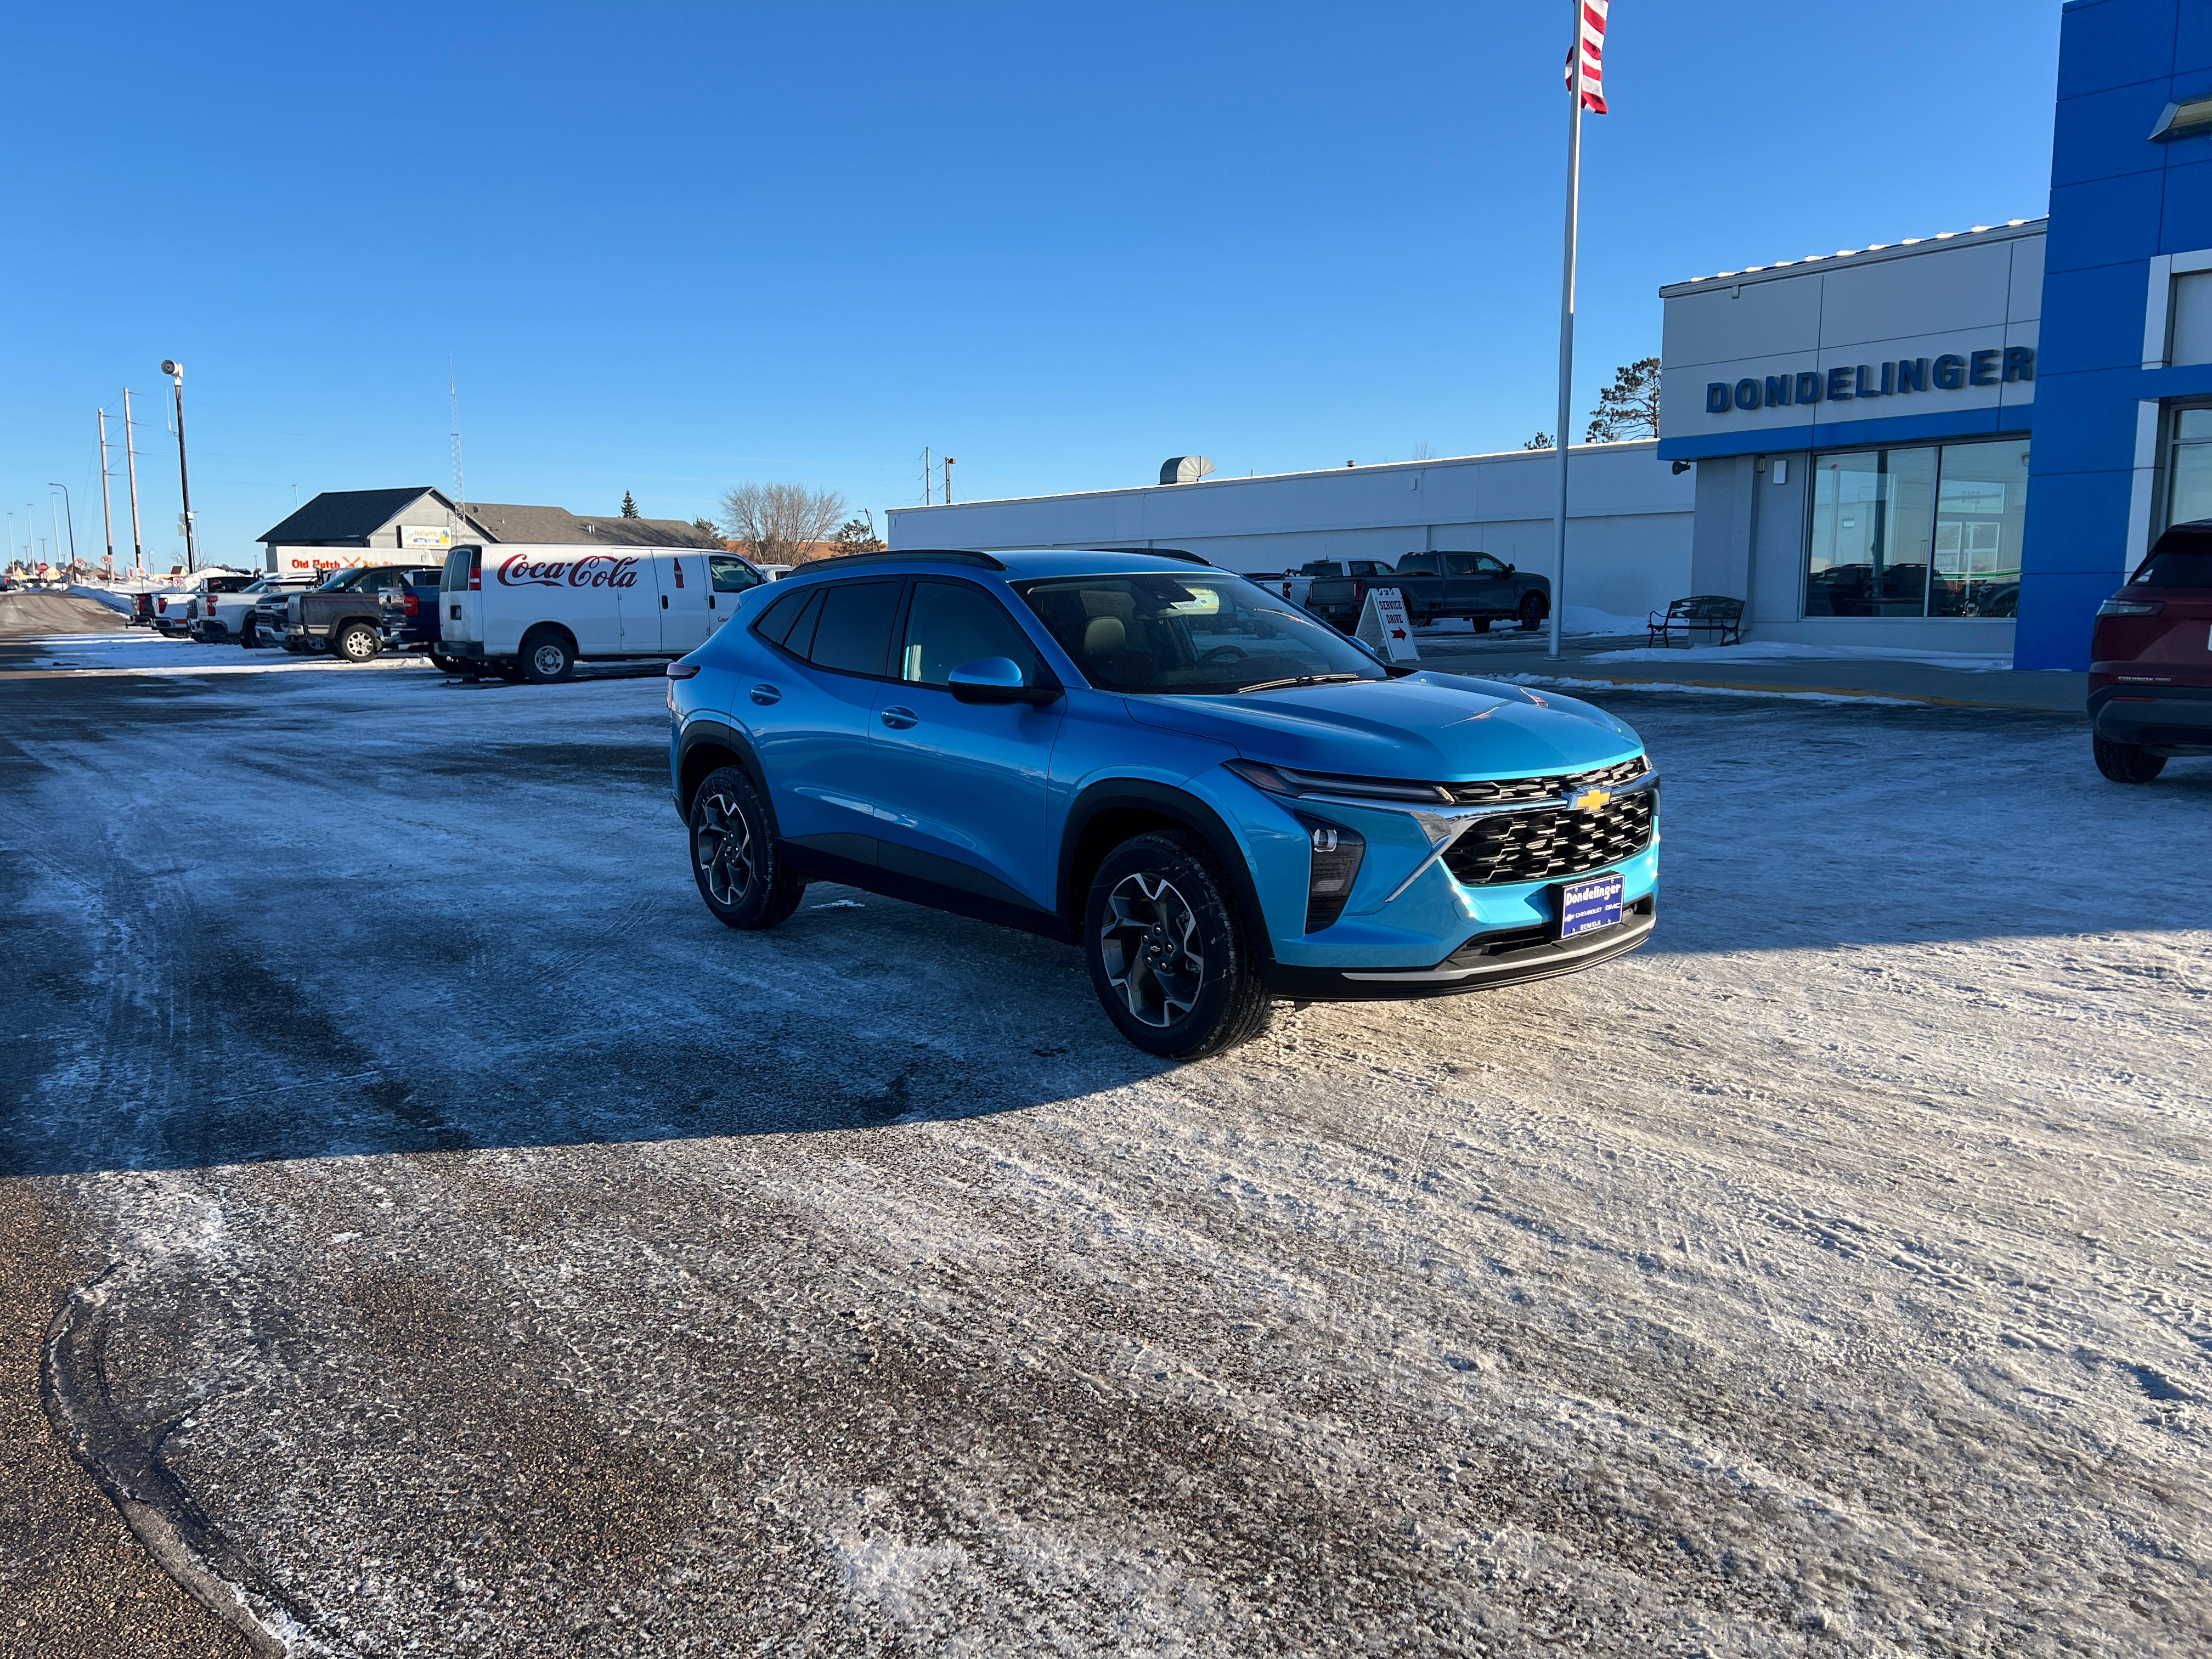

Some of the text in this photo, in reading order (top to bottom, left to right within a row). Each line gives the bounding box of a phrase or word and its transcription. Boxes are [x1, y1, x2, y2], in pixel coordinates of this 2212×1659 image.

[1706, 346, 2034, 413] DONDELINGER
[292, 560, 309, 568] Old
[497, 554, 640, 588] Coca-Cola
[1379, 601, 1402, 610] SERVICE
[1386, 614, 1403, 624] DRIVE
[1566, 884, 1621, 906] Dondelinger
[1576, 902, 1621, 918] CHEVROLET GMC
[1580, 920, 1601, 930] BEMIDJI
